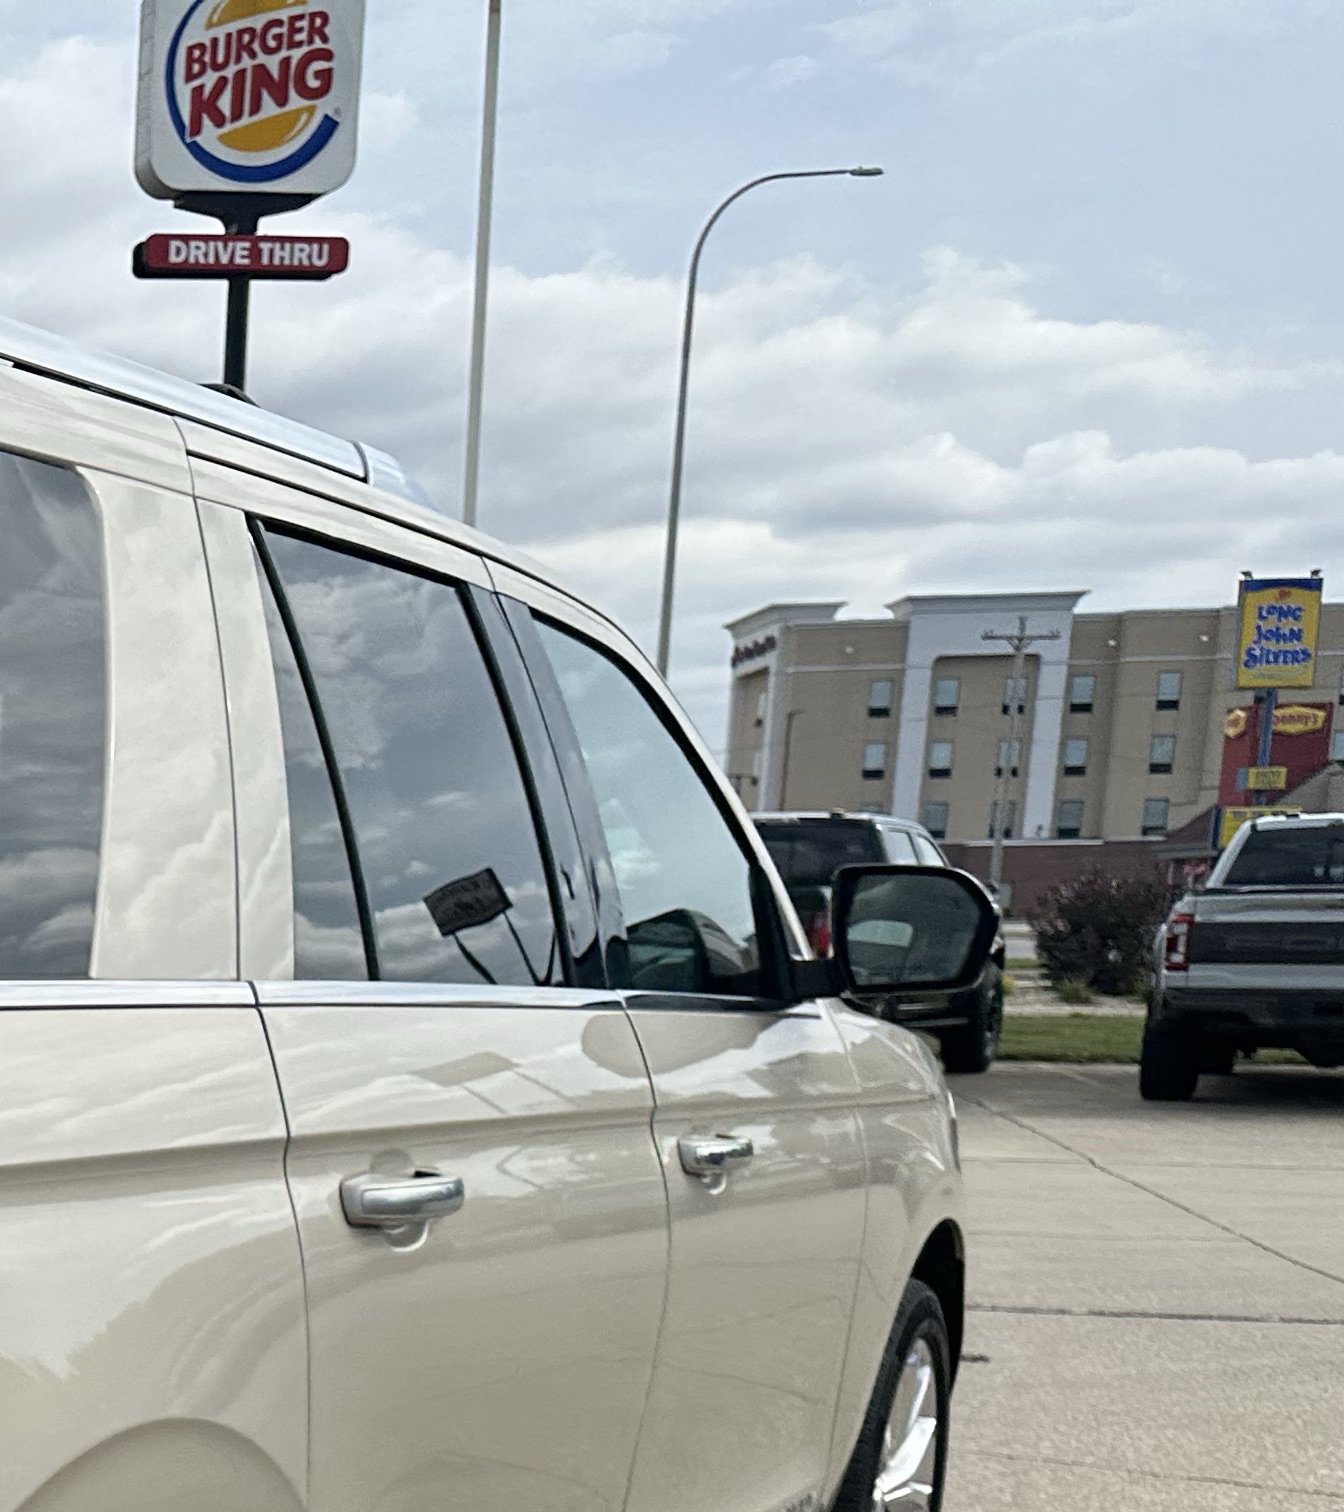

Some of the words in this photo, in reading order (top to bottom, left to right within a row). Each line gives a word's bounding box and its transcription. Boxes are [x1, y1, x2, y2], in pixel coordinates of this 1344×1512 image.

[185, 11, 330, 83] BURGER
[188, 48, 334, 138] KING
[168, 240, 250, 266] DRIVE
[260, 242, 329, 267] THRU
